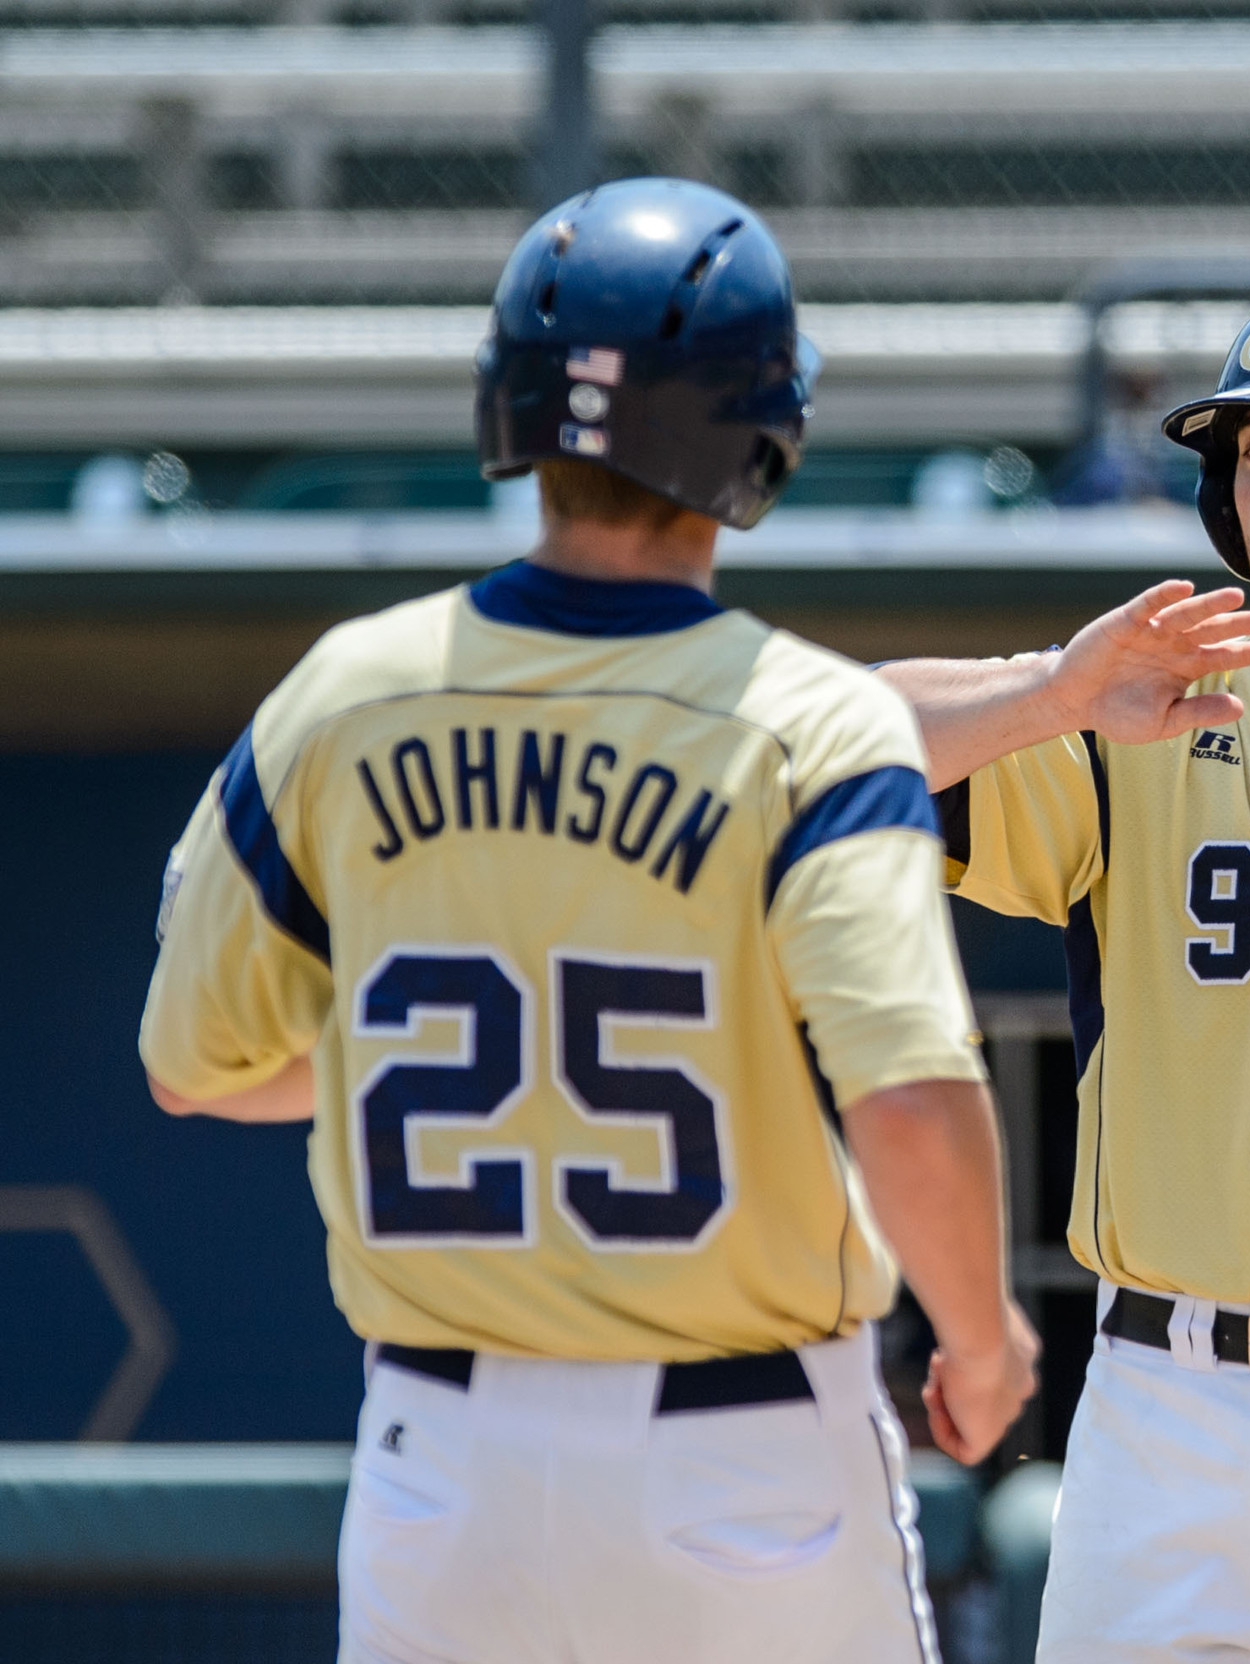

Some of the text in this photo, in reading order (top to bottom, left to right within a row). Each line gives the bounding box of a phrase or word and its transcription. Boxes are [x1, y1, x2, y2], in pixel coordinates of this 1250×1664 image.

[356, 727, 730, 895] JOHNSON
[1190, 748, 1241, 765] RUSSELL
[353, 944, 735, 1253] 25
